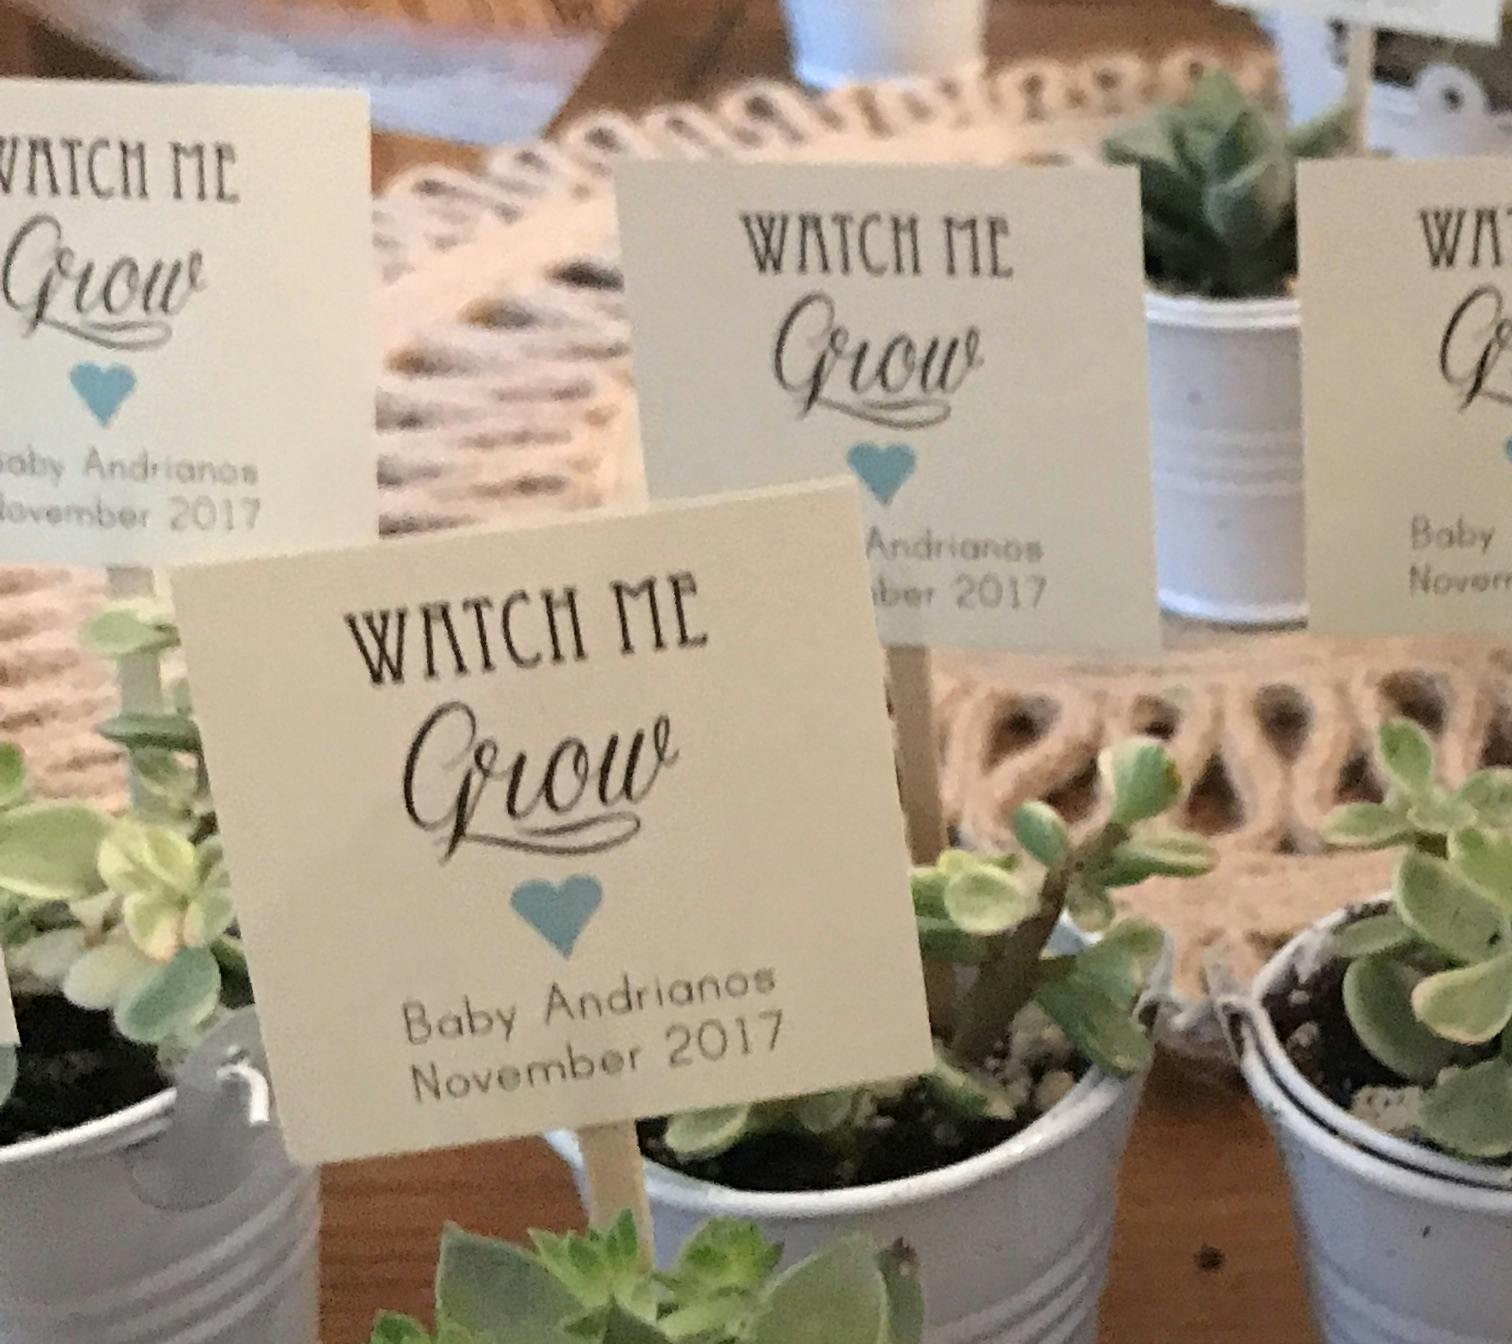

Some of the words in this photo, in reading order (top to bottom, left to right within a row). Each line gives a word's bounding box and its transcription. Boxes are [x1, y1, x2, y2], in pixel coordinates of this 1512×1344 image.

[169, 141, 241, 204] ME
[739, 210, 923, 278] WATCH
[943, 212, 1015, 280] ME
[2, 214, 208, 350] Grow
[772, 291, 985, 431] Grow
[0, 443, 65, 488] aby
[84, 444, 259, 485] Andrianos
[0, 494, 151, 530] ovember
[169, 495, 261, 531] 2017
[866, 525, 1044, 563] Andrianos
[1409, 512, 1496, 555] Baby
[955, 572, 1048, 609] 2017
[342, 584, 591, 689] WATCH
[609, 568, 709, 656] ME
[402, 700, 680, 865] Grow
[402, 999, 518, 1048] Baby
[542, 966, 779, 1026] Andrianos
[410, 1048, 642, 1104] November
[665, 1009, 786, 1069] 2017
